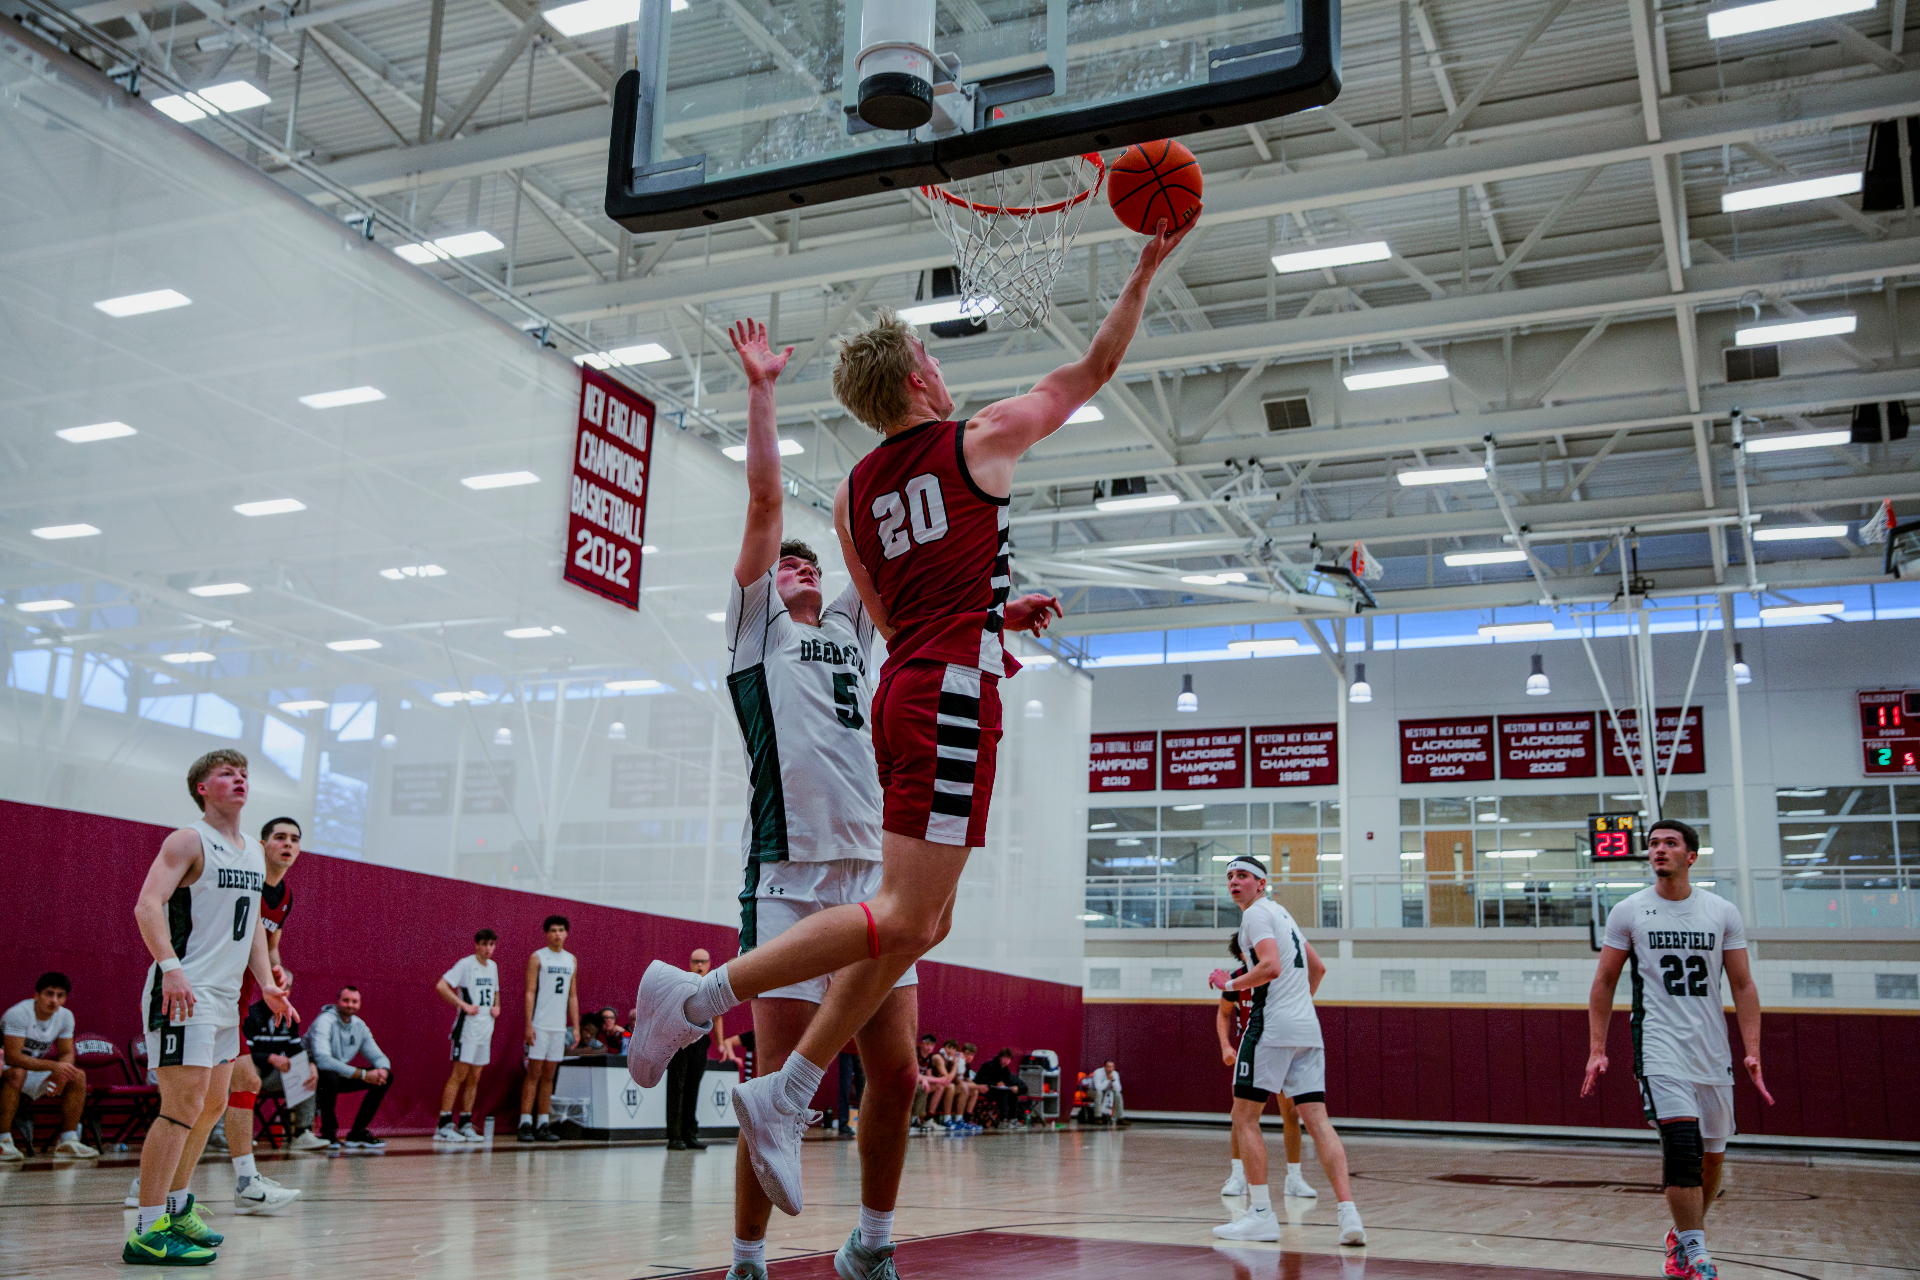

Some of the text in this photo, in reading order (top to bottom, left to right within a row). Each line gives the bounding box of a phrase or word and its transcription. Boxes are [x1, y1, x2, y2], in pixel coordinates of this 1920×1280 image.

[583, 382, 648, 452] NEW ENGLAND
[579, 430, 644, 497] CHAMPIONS
[571, 475, 642, 546] BASKETBALL
[871, 472, 949, 561] 20
[575, 528, 632, 588] 2012
[832, 672, 865, 730] 5
[1878, 706, 1900, 727] 11
[1405, 725, 1488, 738] WESTERN NEW ENGLAND
[1503, 720, 1590, 733] WESTERN NEW ENGLAND
[1196, 736, 1210, 747] NEW
[1211, 735, 1242, 746] ENGLAND
[1287, 733, 1301, 743] NEW
[1303, 731, 1333, 742] ENGLAND
[1412, 738, 1481, 751] LACROSSE
[1511, 734, 1583, 747] LACROSSE
[1171, 747, 1235, 761] LACROSSE
[1261, 744, 1327, 757] LACROSSE
[1509, 747, 1586, 760] CHAMPIONS
[1878, 748, 1892, 766] 2
[1170, 760, 1236, 774] CHAMPIONS
[1260, 757, 1329, 770] CHAMPIONS
[1429, 765, 1465, 777] 2004
[1101, 776, 1131, 787] 2010
[1596, 832, 1628, 856] 23
[233, 896, 250, 941] 0
[1648, 931, 1715, 951] DEERFIELD
[555, 976, 564, 994] 2
[1660, 955, 1708, 997] 22
[479, 988, 491, 1006] 15
[166, 1034, 177, 1055] D
[1239, 1061, 1249, 1076] D
